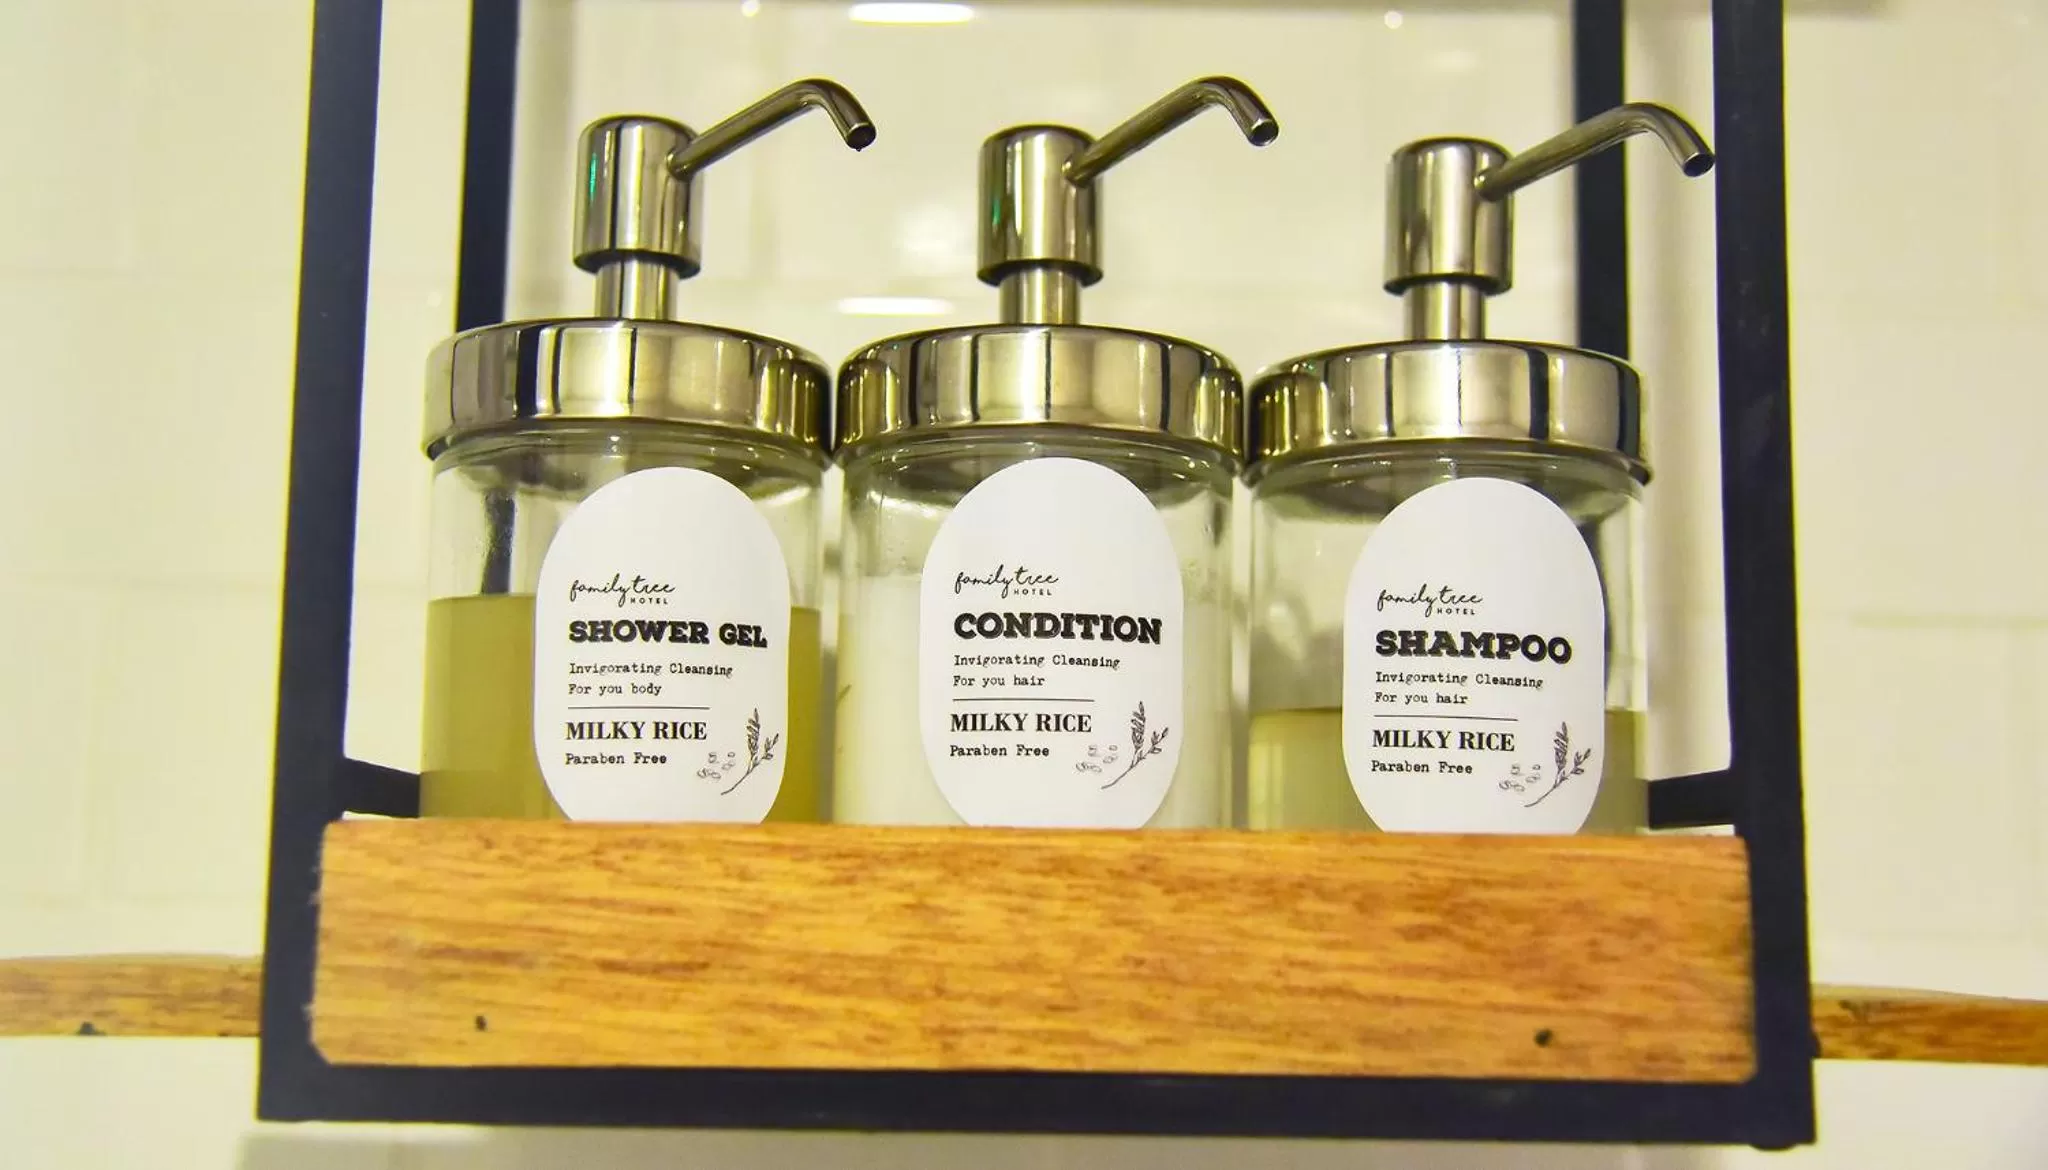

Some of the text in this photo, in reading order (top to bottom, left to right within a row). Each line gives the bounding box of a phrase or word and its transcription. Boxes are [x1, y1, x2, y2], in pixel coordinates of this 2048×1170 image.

[954, 564, 1059, 599] family tree
[570, 573, 676, 607] family tree
[1013, 588, 1053, 596] HOTEL
[1376, 583, 1483, 617] family tree
[1437, 608, 1476, 616] HOTEL
[569, 619, 768, 648] SHOWER GEL
[953, 611, 1163, 645] CONDITION
[1375, 629, 1573, 664] SHAMPOO
[569, 662, 733, 677] Invigorating Cleansing
[953, 654, 1121, 669] Invigorating Cleansing
[953, 674, 1046, 688] For you hair
[1375, 671, 1544, 689] Invigorating Cleansing
[568, 682, 662, 697] For you body
[1374, 692, 1469, 705] For you hair
[565, 721, 707, 741] MILKY RICE
[950, 713, 1092, 733] MILKY RICE
[1372, 729, 1515, 752] MILKY RICE
[565, 751, 667, 765] Paraben Free
[949, 744, 1050, 757] Paraben Free
[1371, 759, 1473, 774] Paraben Free
